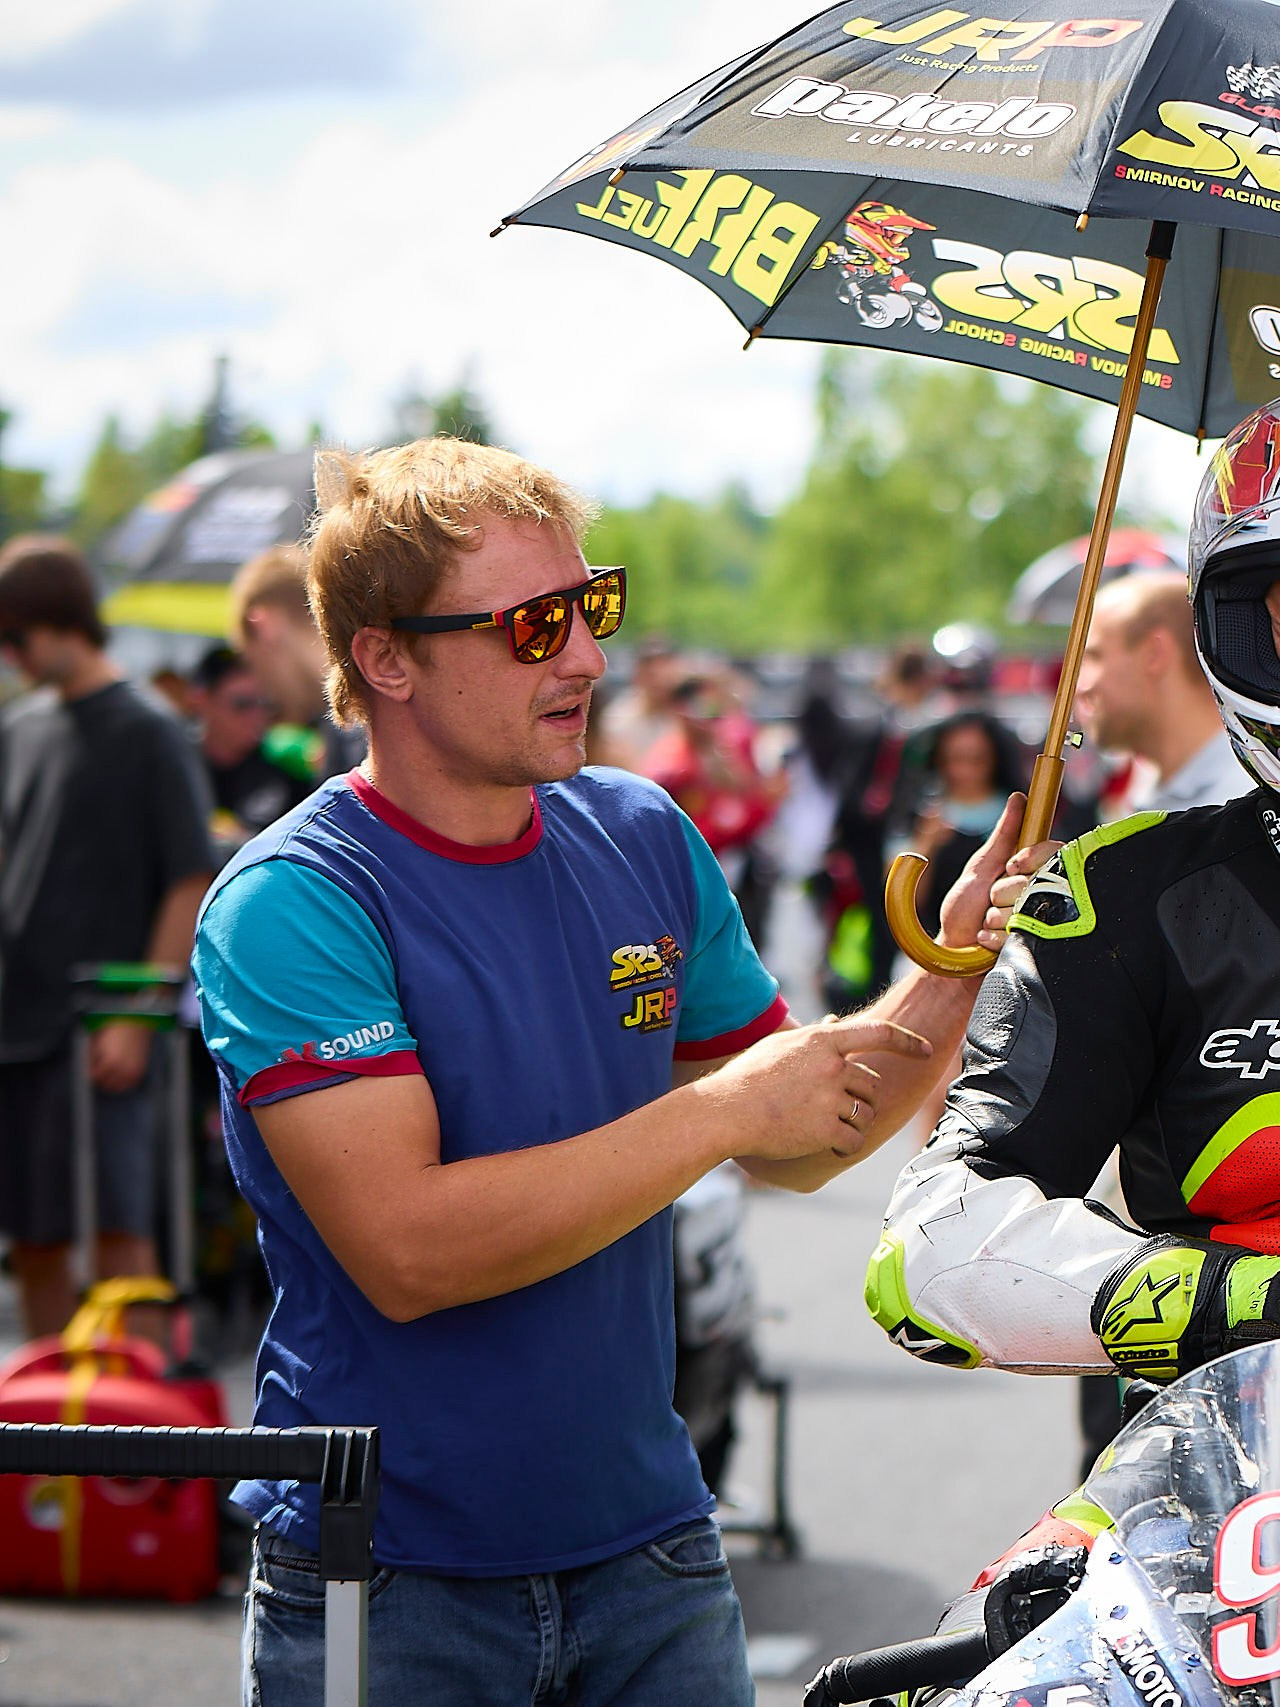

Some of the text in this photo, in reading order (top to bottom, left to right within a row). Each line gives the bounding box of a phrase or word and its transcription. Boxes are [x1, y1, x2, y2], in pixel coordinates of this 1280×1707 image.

[842, 9, 1143, 62] JRP
[896, 53, 1039, 74] Just Racing Products
[750, 76, 1078, 139] pakelo
[846, 131, 1034, 157] LUBRICANTS
[1114, 164, 1205, 193] SMIRNOV
[610, 944, 663, 981] SRS
[624, 987, 677, 1027] JRP
[320, 1021, 395, 1060] SOUND
